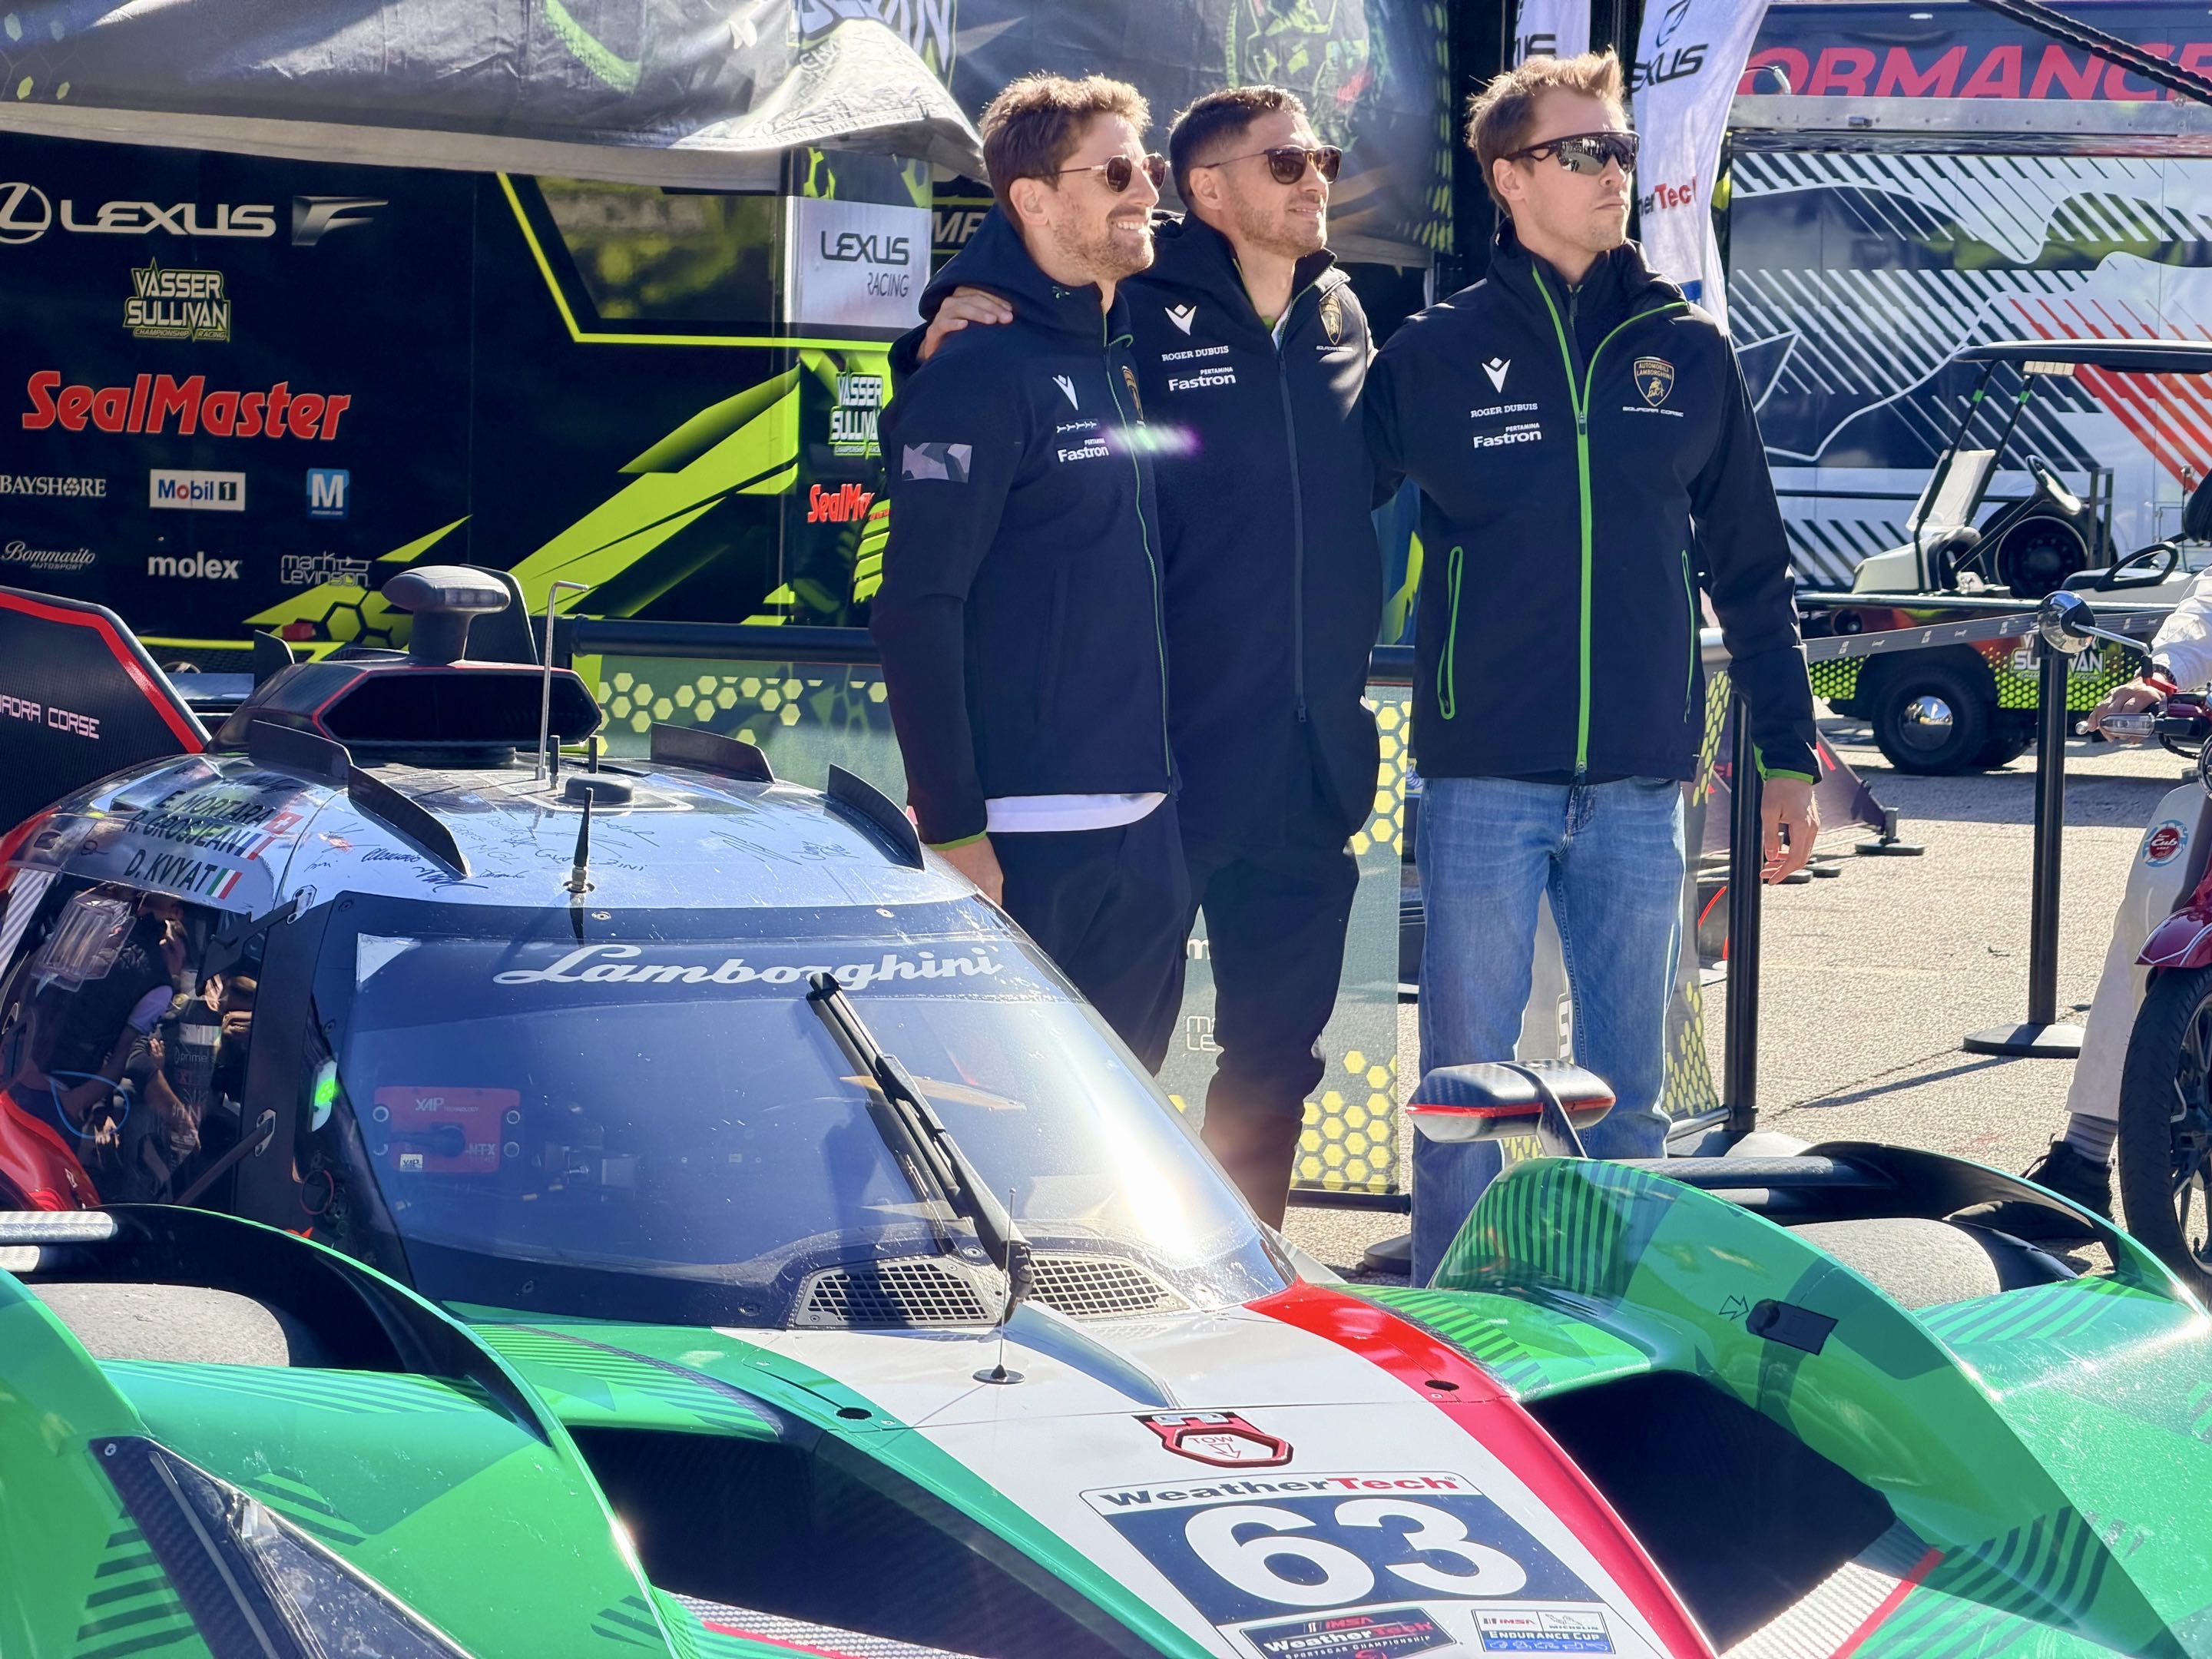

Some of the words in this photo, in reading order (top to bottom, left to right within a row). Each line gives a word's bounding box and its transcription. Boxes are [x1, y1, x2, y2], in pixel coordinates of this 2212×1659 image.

[61, 199, 276, 237] LEXUS
[821, 230, 910, 266] LEXUS
[135, 269, 221, 300] VASSER
[127, 300, 227, 329] SULLIVAN
[1161, 351, 1194, 362] ROGER
[1194, 345, 1230, 358] DUBUIS
[1168, 374, 1237, 392] Fastron
[1200, 366, 1233, 375] PERTAMINA
[22, 370, 353, 440] SealMaster
[838, 376, 883, 407] VASSER
[1471, 406, 1503, 418] ROGER
[1504, 402, 1538, 413] DUBUIS
[1473, 431, 1542, 449] Fastron
[1505, 422, 1541, 432] PERTAMINA
[1058, 446, 1110, 462] Fastron
[0, 475, 107, 497] BAYSHORE
[158, 479, 214, 500] Mobil
[312, 473, 345, 508] M
[2, 541, 96, 565] Bommarito
[148, 551, 240, 580] molex
[0, 694, 41, 724] ADRA
[48, 707, 100, 740] CORSE
[124, 849, 146, 878] D.
[144, 853, 218, 892] KVYAT
[492, 943, 1005, 991] Lamborghini
[1189, 1435, 1233, 1445] TOW
[1099, 1476, 1458, 1507] WeatherTech
[1185, 1498, 1527, 1607] 63
[1263, 1621, 1433, 1652] WeatherTech
[1352, 1635, 1431, 1651] CHAMPIONSHIP
